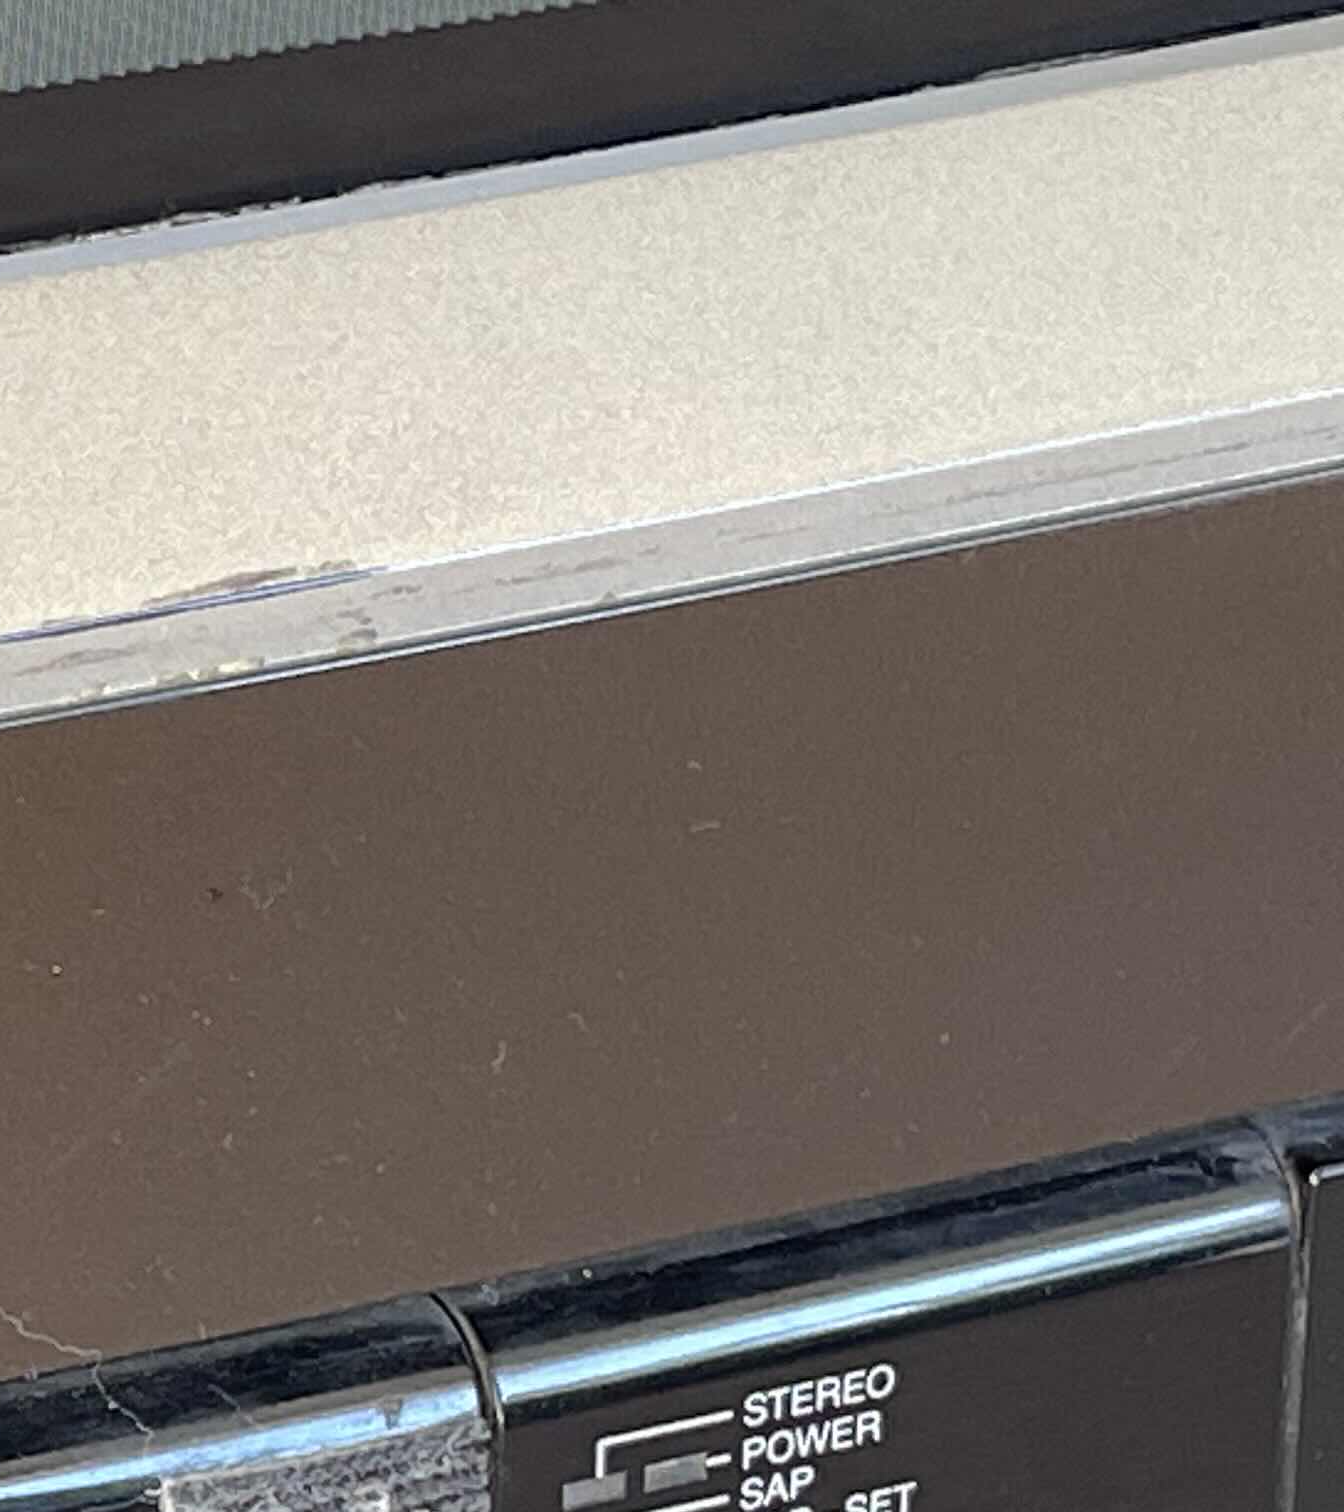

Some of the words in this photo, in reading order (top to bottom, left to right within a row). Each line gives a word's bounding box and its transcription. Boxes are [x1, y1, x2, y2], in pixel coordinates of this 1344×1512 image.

[742, 1363, 896, 1428] STEREO
[741, 1409, 883, 1471] POWER
[739, 1466, 816, 1512] SAP
